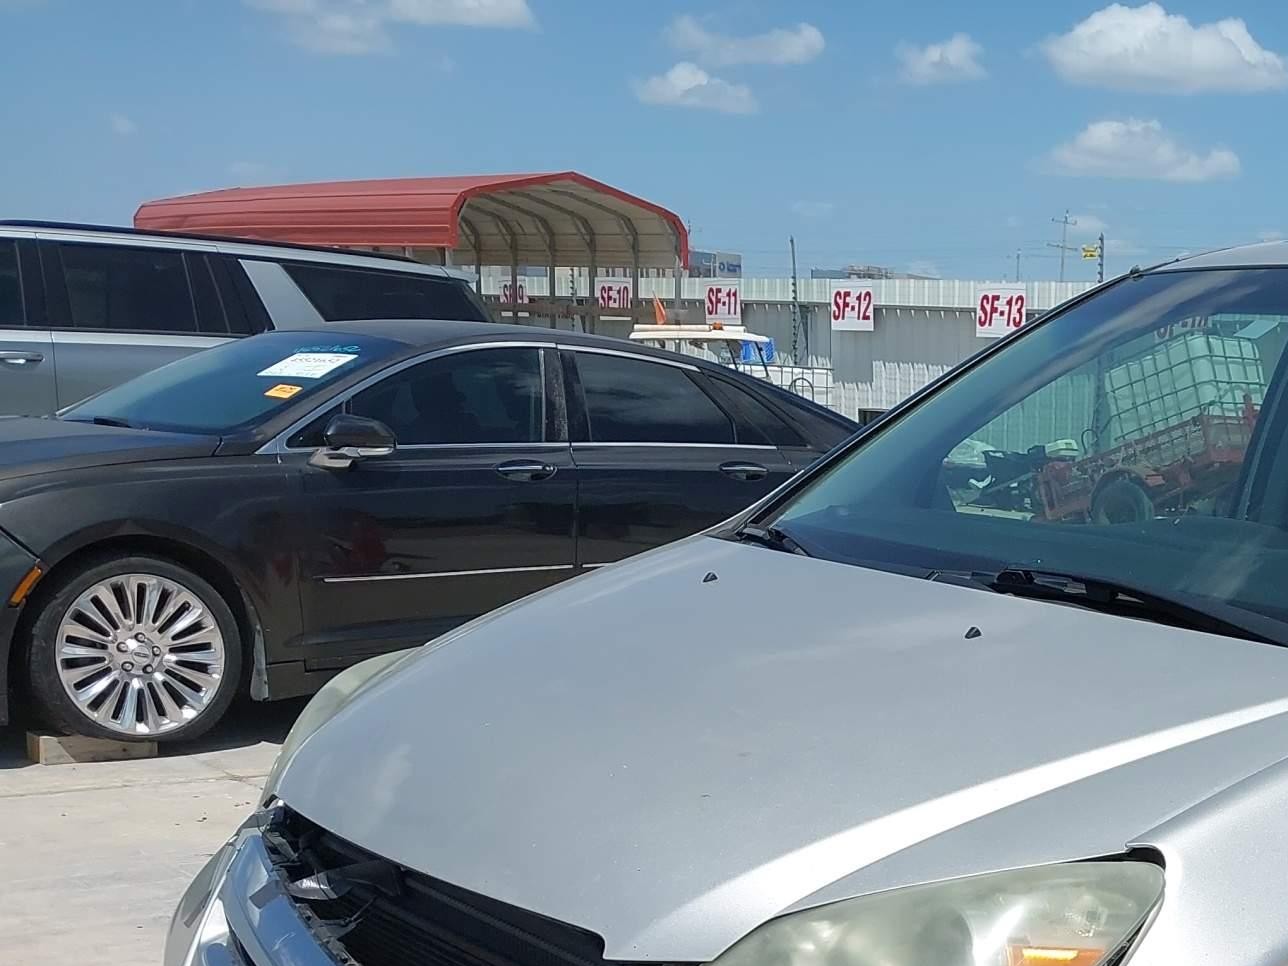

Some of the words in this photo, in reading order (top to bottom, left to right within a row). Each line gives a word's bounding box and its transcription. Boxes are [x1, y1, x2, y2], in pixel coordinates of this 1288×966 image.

[600, 285, 630, 309] SF-10
[707, 287, 738, 315] SF-11
[832, 290, 872, 321] SF-12
[978, 294, 1025, 328] SF-13
